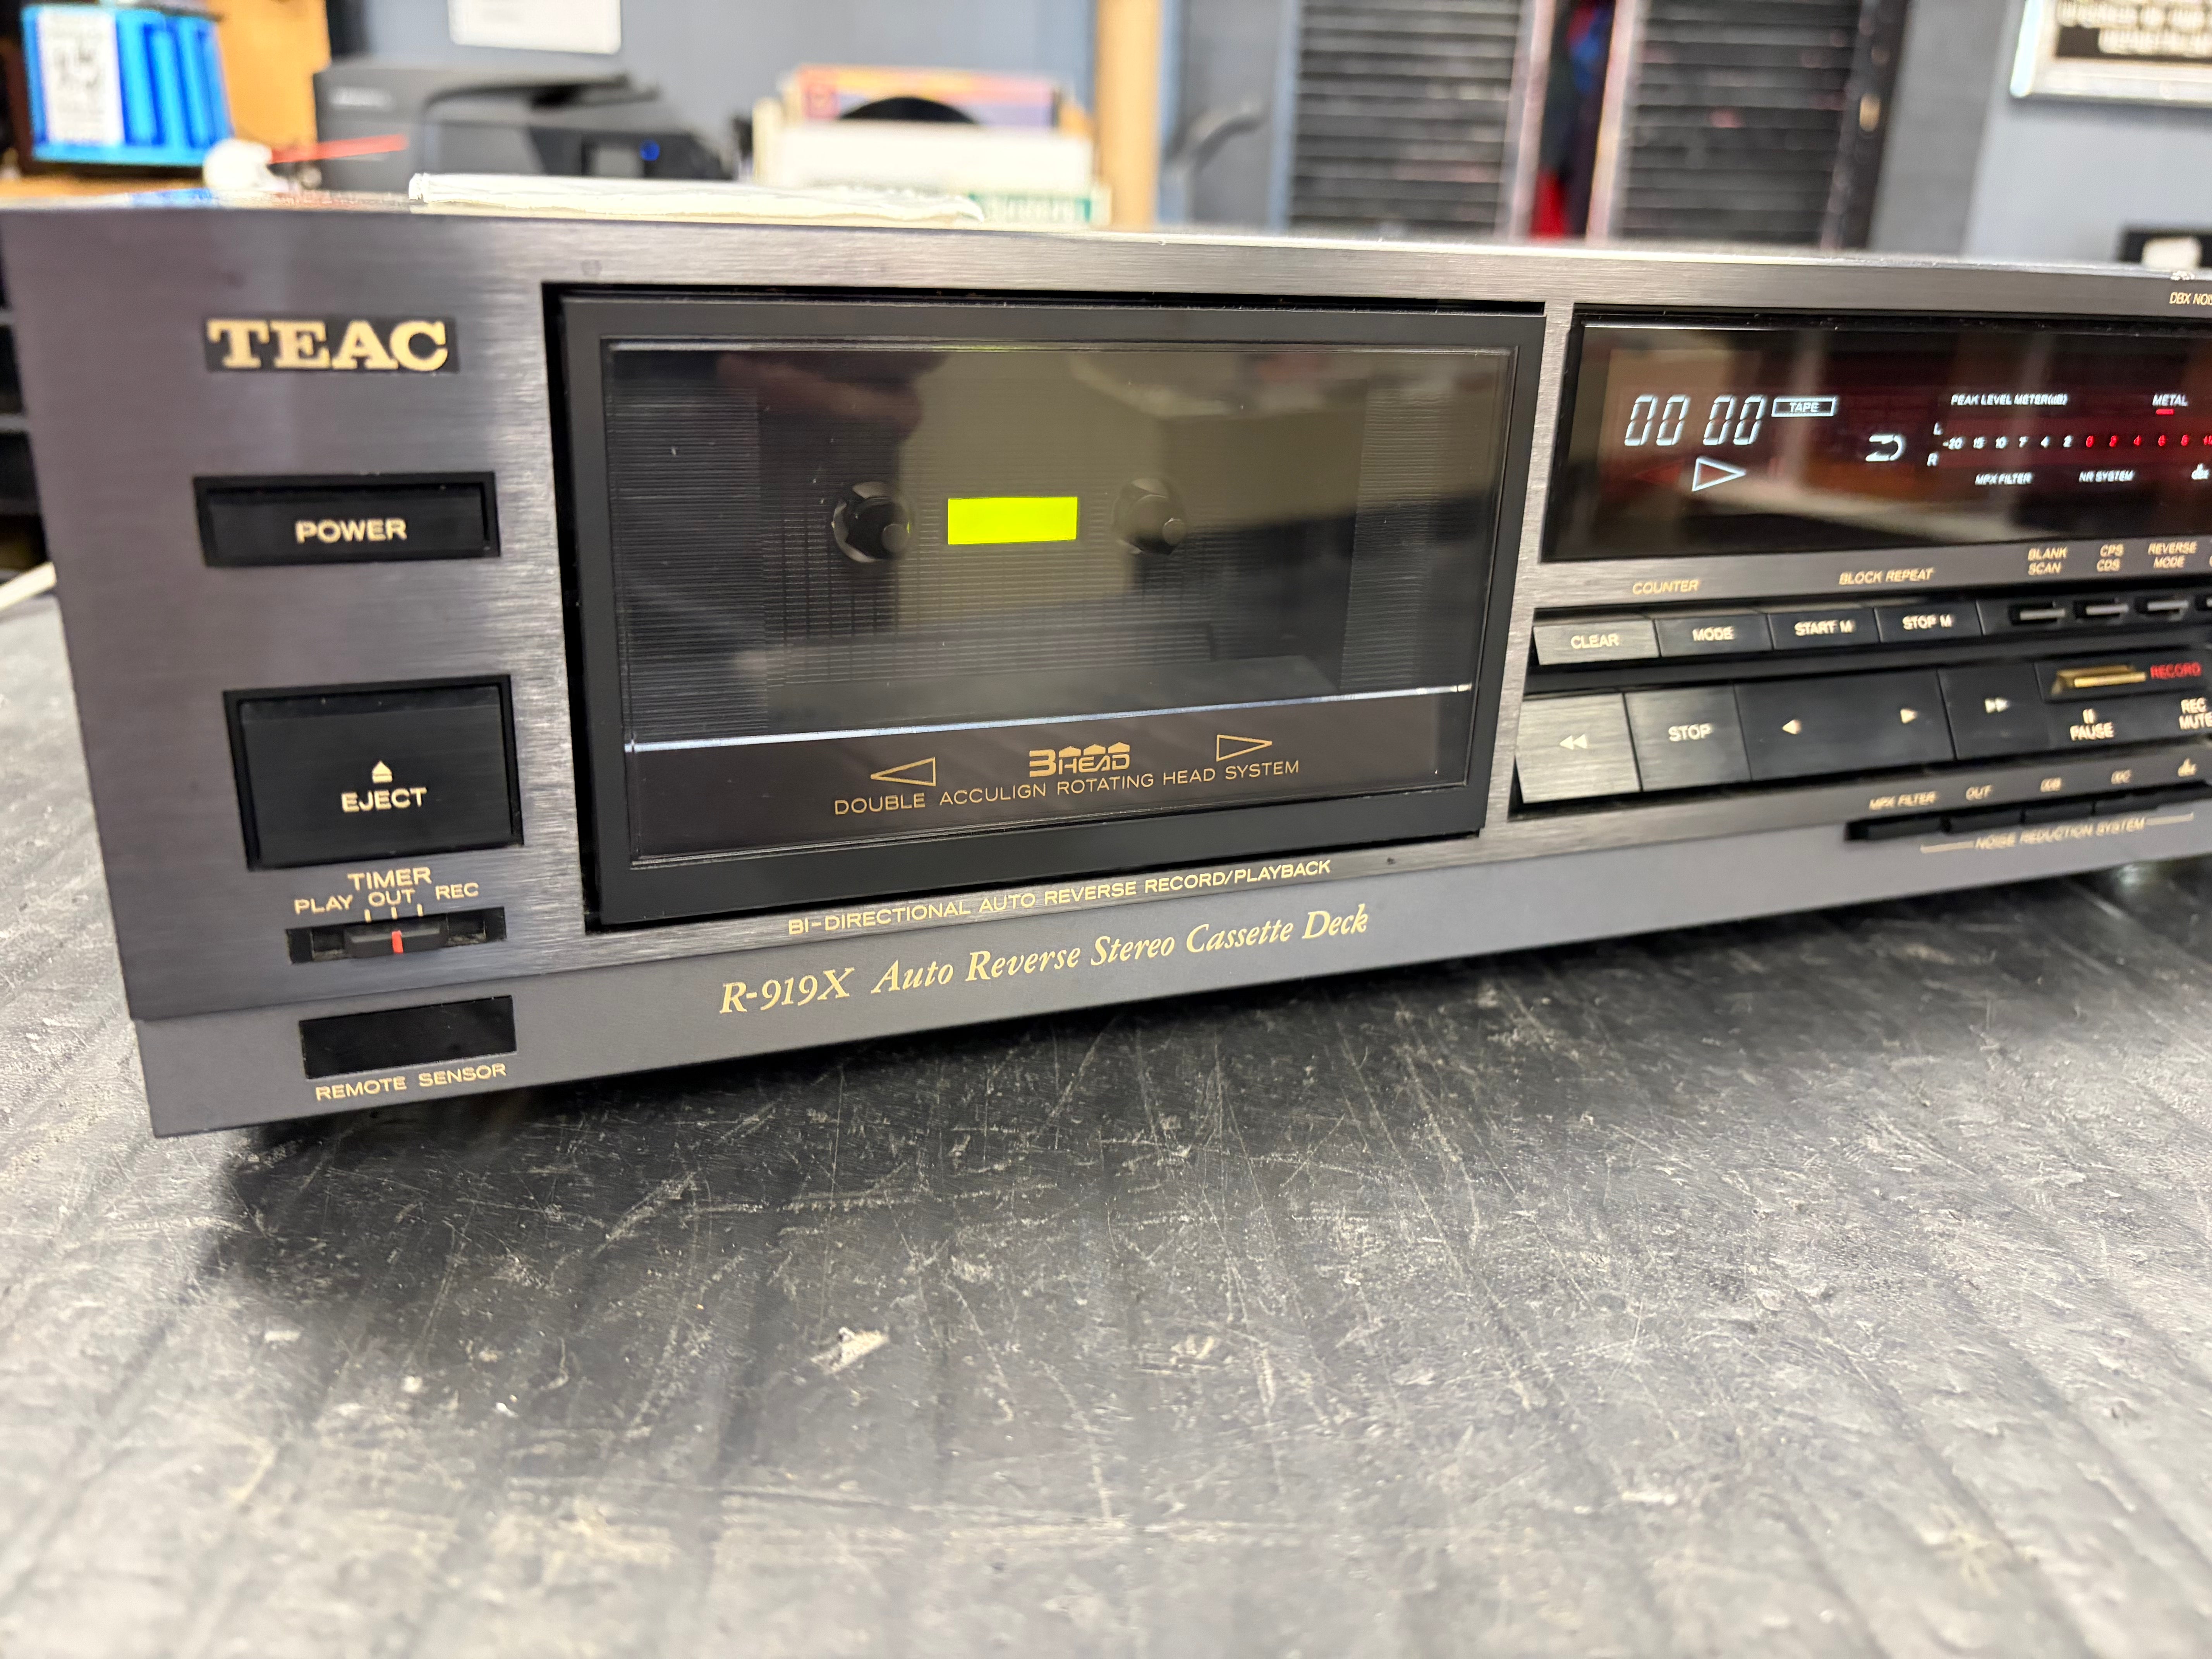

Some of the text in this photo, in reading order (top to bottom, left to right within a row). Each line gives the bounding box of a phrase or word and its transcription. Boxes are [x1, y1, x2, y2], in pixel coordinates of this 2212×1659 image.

[2169, 292, 2191, 304] DBX
[206, 318, 448, 371] TEAC
[1951, 393, 1980, 405] PEAK
[1980, 393, 2013, 405] LEVEL
[2152, 393, 2188, 406] METAL
[1789, 402, 1820, 413] TAPE
[1933, 422, 1943, 435] L
[1995, 436, 2009, 449] 10
[2019, 436, 2029, 448] 7
[2040, 436, 2051, 448] 4
[2086, 435, 2094, 447] 0
[2133, 435, 2141, 446] 4
[1927, 452, 1939, 467] R
[1975, 472, 2033, 485] MPX FILTER
[2079, 469, 2135, 483] NR SYSTEM
[295, 518, 407, 543] POWER
[2028, 546, 2068, 561] BLANK
[2100, 544, 2124, 557] CPS
[2148, 541, 2198, 555] REVERSE
[2028, 562, 2061, 575] SCAN
[2153, 555, 2186, 568] MODE
[1839, 567, 1934, 585] BLOCK REPEAT
[1632, 579, 1700, 595] COUNTER
[1795, 621, 1838, 637] START
[1902, 614, 1937, 630] STOP
[1570, 634, 1620, 649] CLEAR
[1692, 626, 1735, 642] MODE
[2150, 662, 2202, 680] RECORD
[2181, 697, 2207, 714] REC
[2179, 711, 2212, 730] MUTE
[1668, 723, 1714, 742] STOP
[2070, 722, 2114, 741] PAUSE
[835, 760, 1300, 816] DOUBLE ACCULIGN ROTATING HEAD SYSTEM
[1966, 785, 1994, 801] OUT
[341, 787, 427, 812] EJECT
[1898, 791, 1937, 807] FILTER
[1975, 816, 2145, 850] NOISE REDUCTION SYSTEM
[347, 867, 432, 891] TIMER
[294, 882, 479, 914] PLAY OUT REC
[788, 859, 1331, 935] BI-DIRECTIONAL AUTO REVERSE RECORD/PLAYBACK
[719, 902, 1369, 1015] R-919X Auto Reverse Stereo Cassette Deck
[315, 1063, 507, 1101] REMOTE SENSOR
